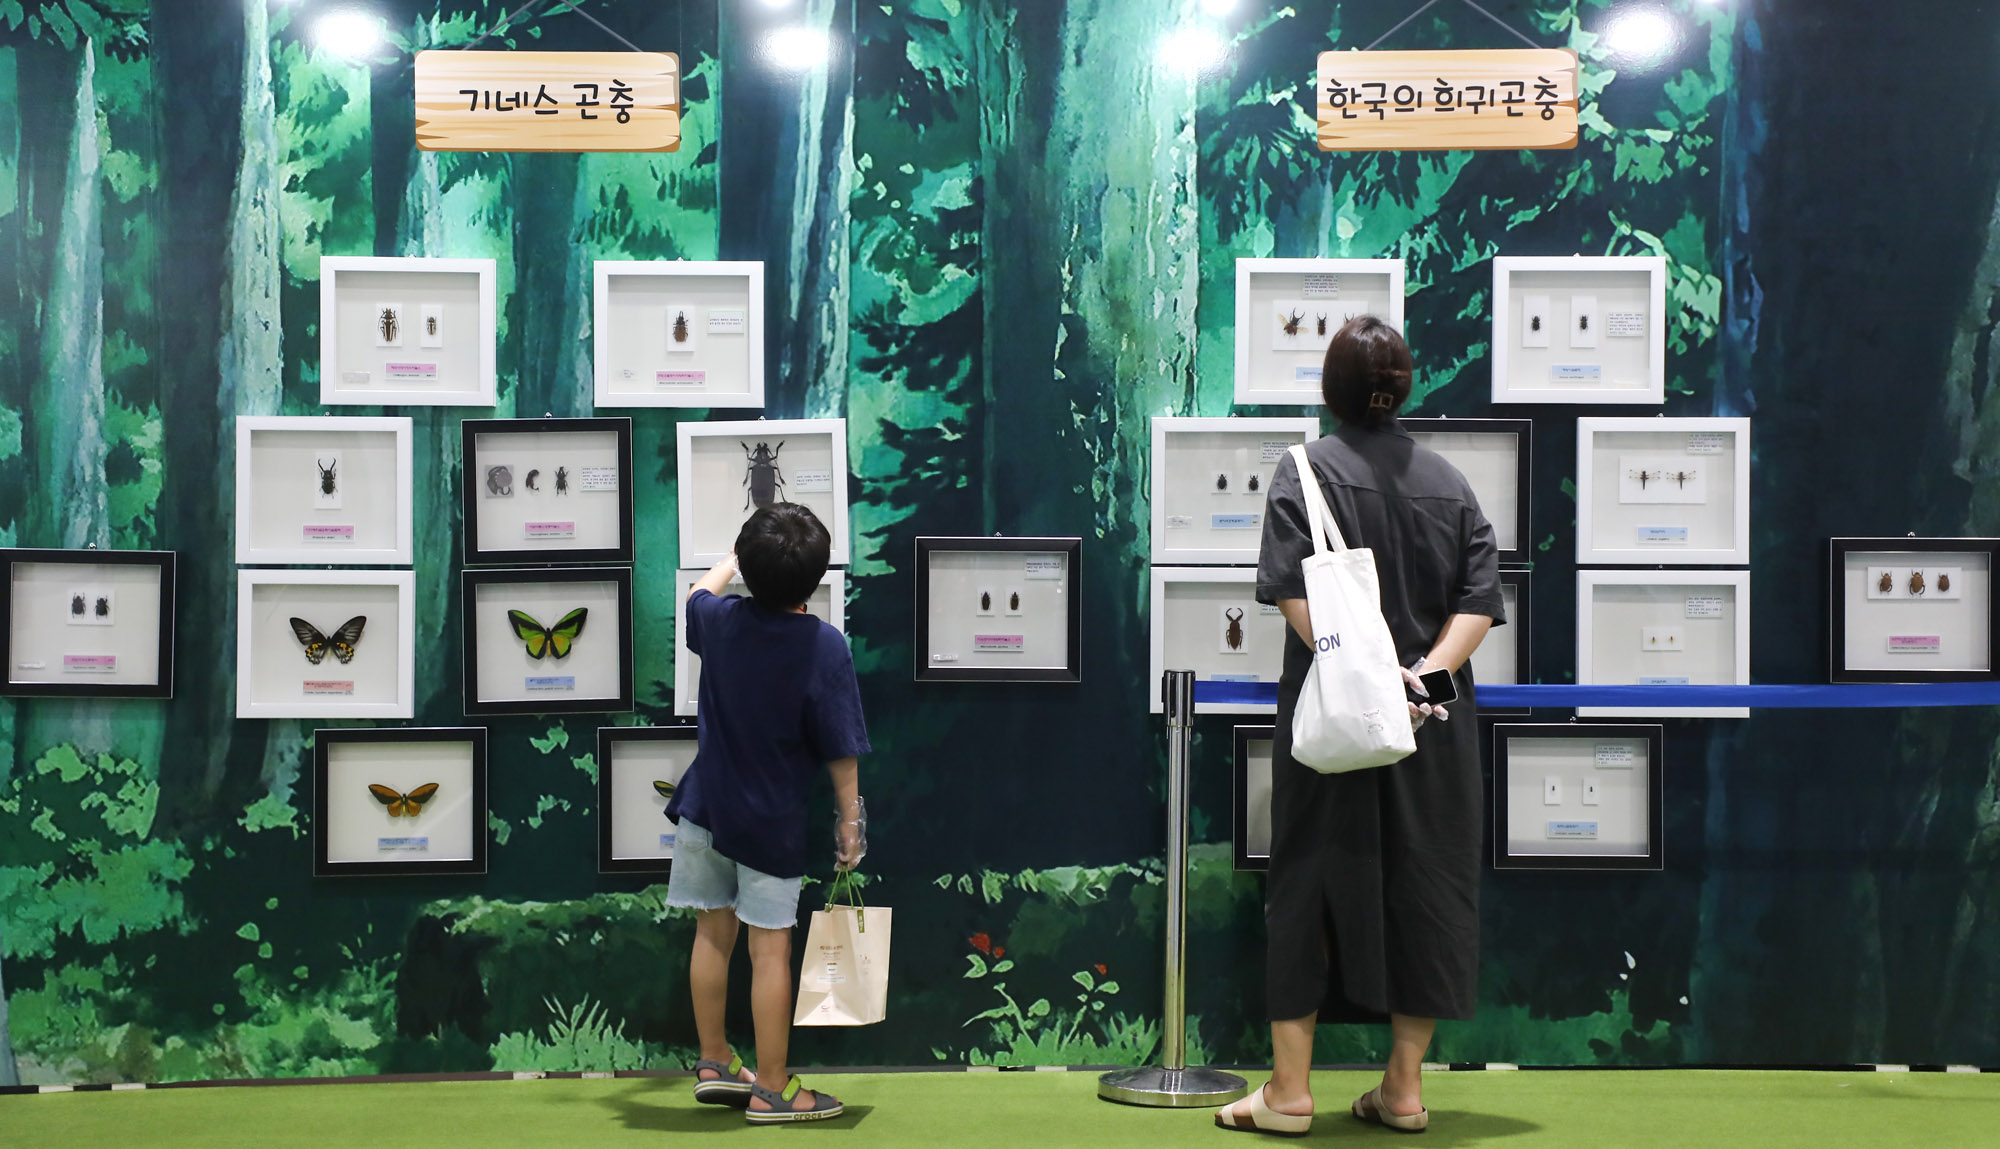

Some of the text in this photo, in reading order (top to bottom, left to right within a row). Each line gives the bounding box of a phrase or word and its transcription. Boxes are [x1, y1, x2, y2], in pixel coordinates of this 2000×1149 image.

[459, 78, 634, 124] 기네스 곤충
[1326, 76, 1559, 121] 한국의 희귀곤충
[793, 1112, 822, 1121] crocs
